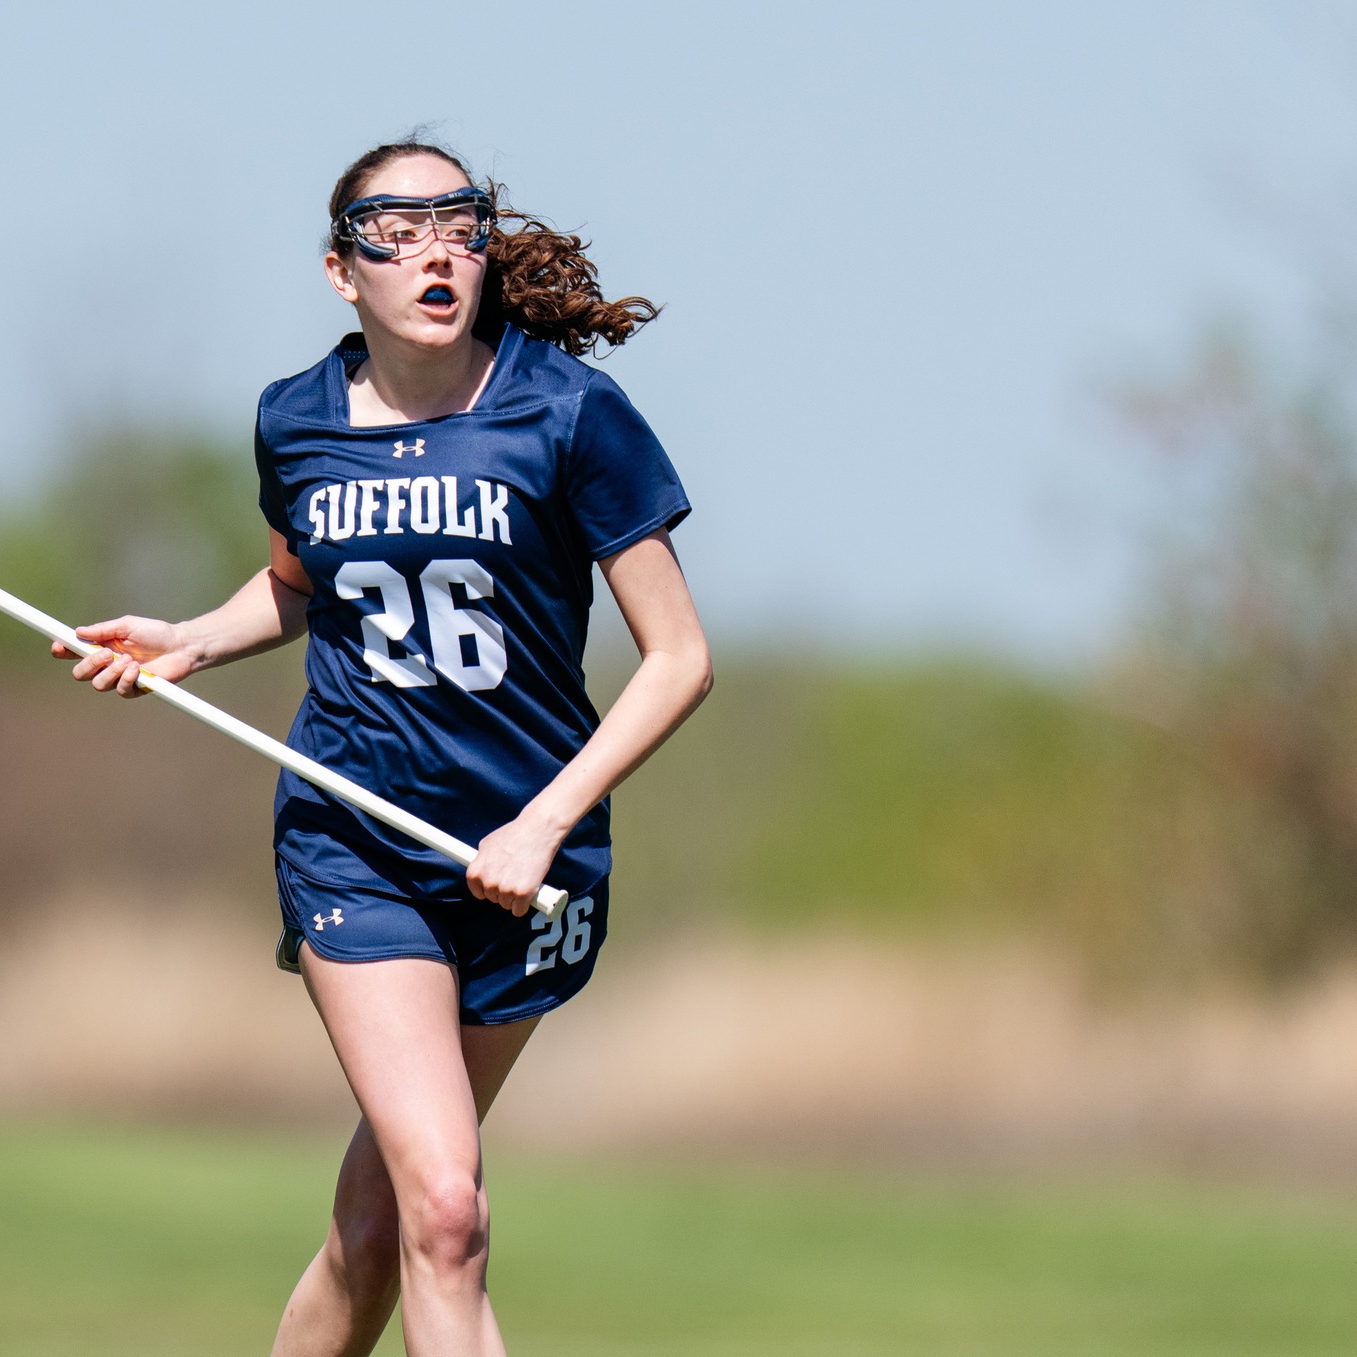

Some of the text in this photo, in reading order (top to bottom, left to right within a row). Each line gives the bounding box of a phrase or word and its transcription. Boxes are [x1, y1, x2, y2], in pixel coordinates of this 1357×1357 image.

[309, 475, 513, 546] SUFFOLK
[335, 558, 508, 692] 26
[525, 895, 595, 977] 26
